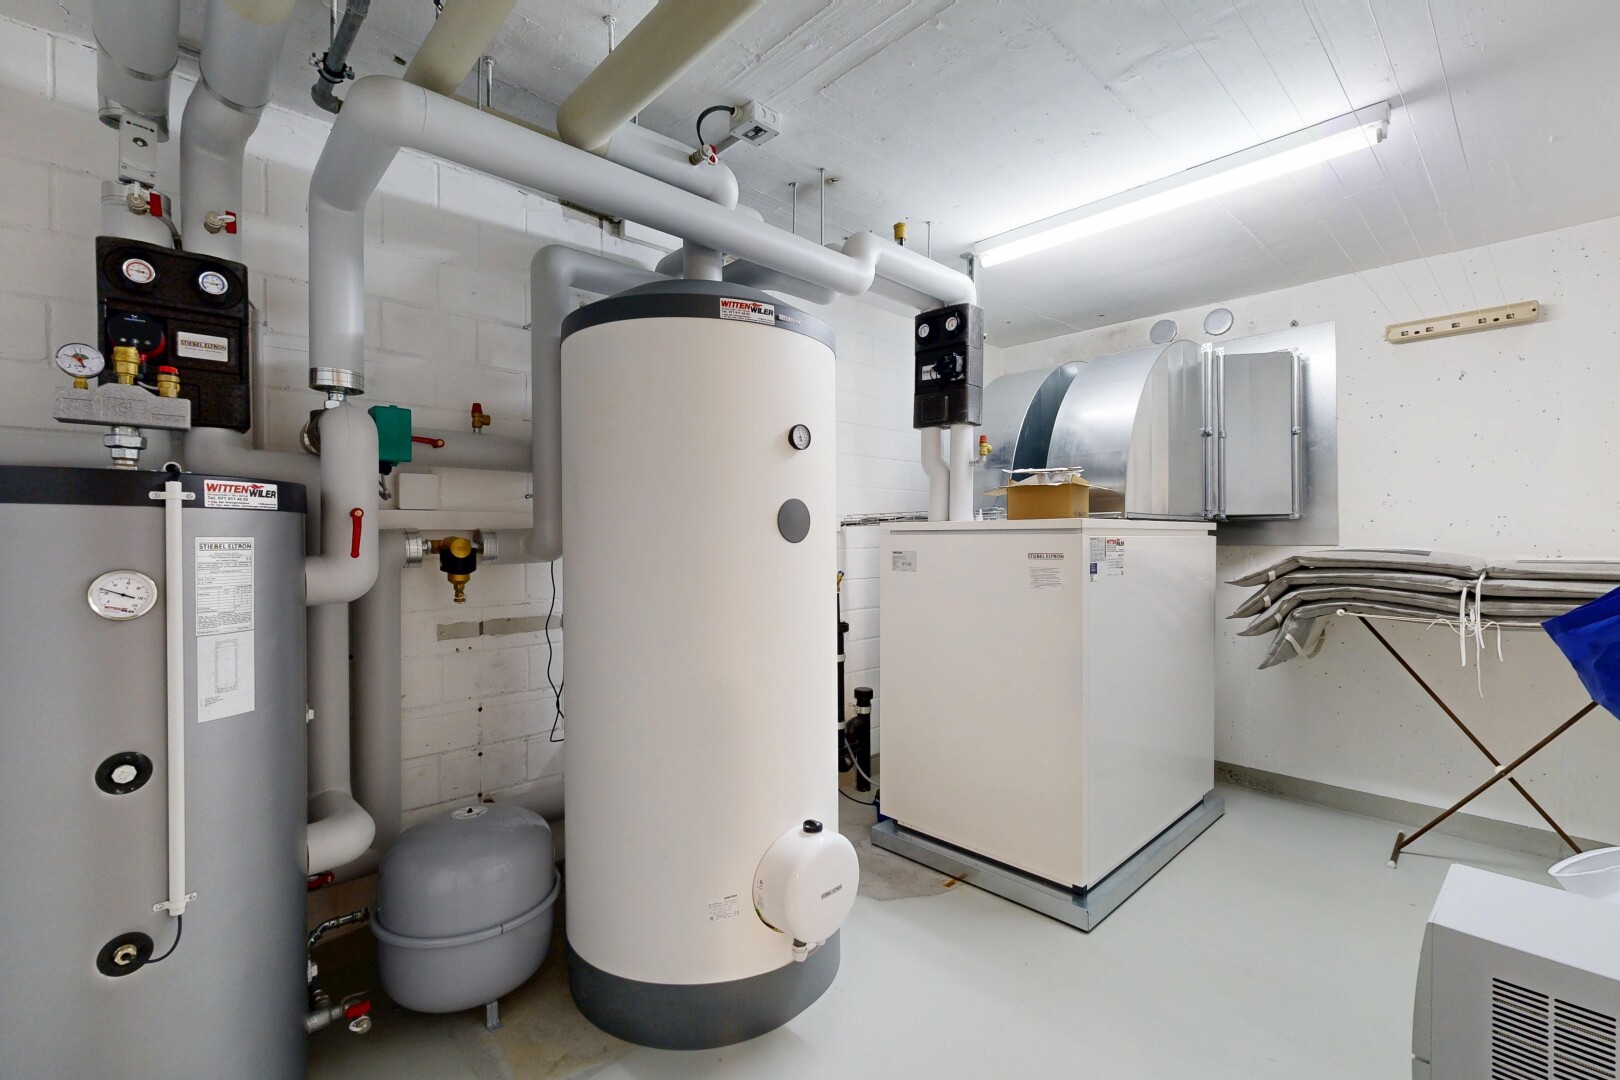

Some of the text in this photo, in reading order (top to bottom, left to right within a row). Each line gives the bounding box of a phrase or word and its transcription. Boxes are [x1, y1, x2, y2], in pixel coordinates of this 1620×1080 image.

[720, 300, 750, 310] WITTEN
[750, 306, 774, 316] WILER
[180, 340, 204, 348] STIEBEL
[205, 343, 226, 351] ELTRON
[206, 483, 249, 493] WITTEN
[249, 489, 276, 498] WILER
